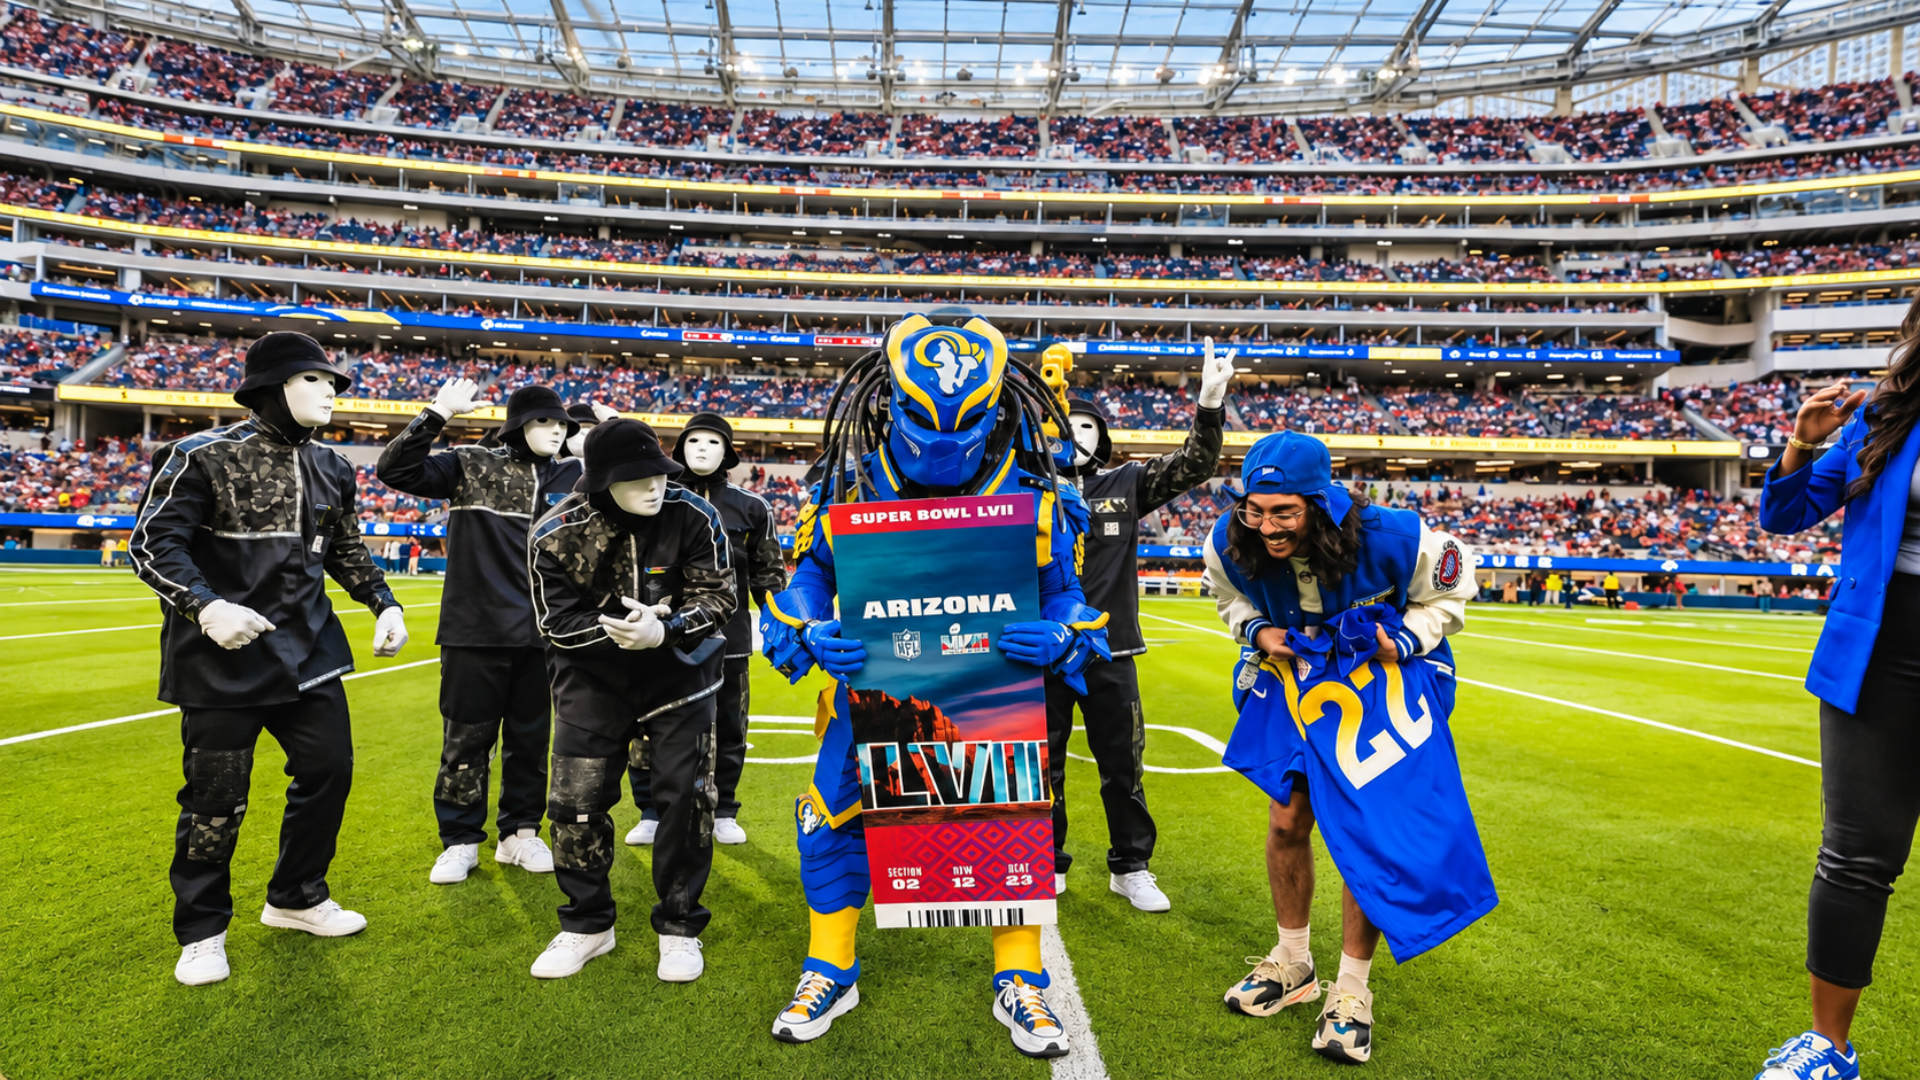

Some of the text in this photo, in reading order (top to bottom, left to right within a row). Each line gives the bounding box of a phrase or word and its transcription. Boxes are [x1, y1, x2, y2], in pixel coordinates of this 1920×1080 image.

[850, 504, 1014, 525] SUPER BOWL LVII
[862, 593, 1017, 620] ARIZONA
[1299, 660, 1434, 791] 22
[857, 740, 1050, 811] LVII
[892, 878, 920, 890] 02
[951, 876, 976, 888] 12
[1005, 874, 1033, 886] 23
